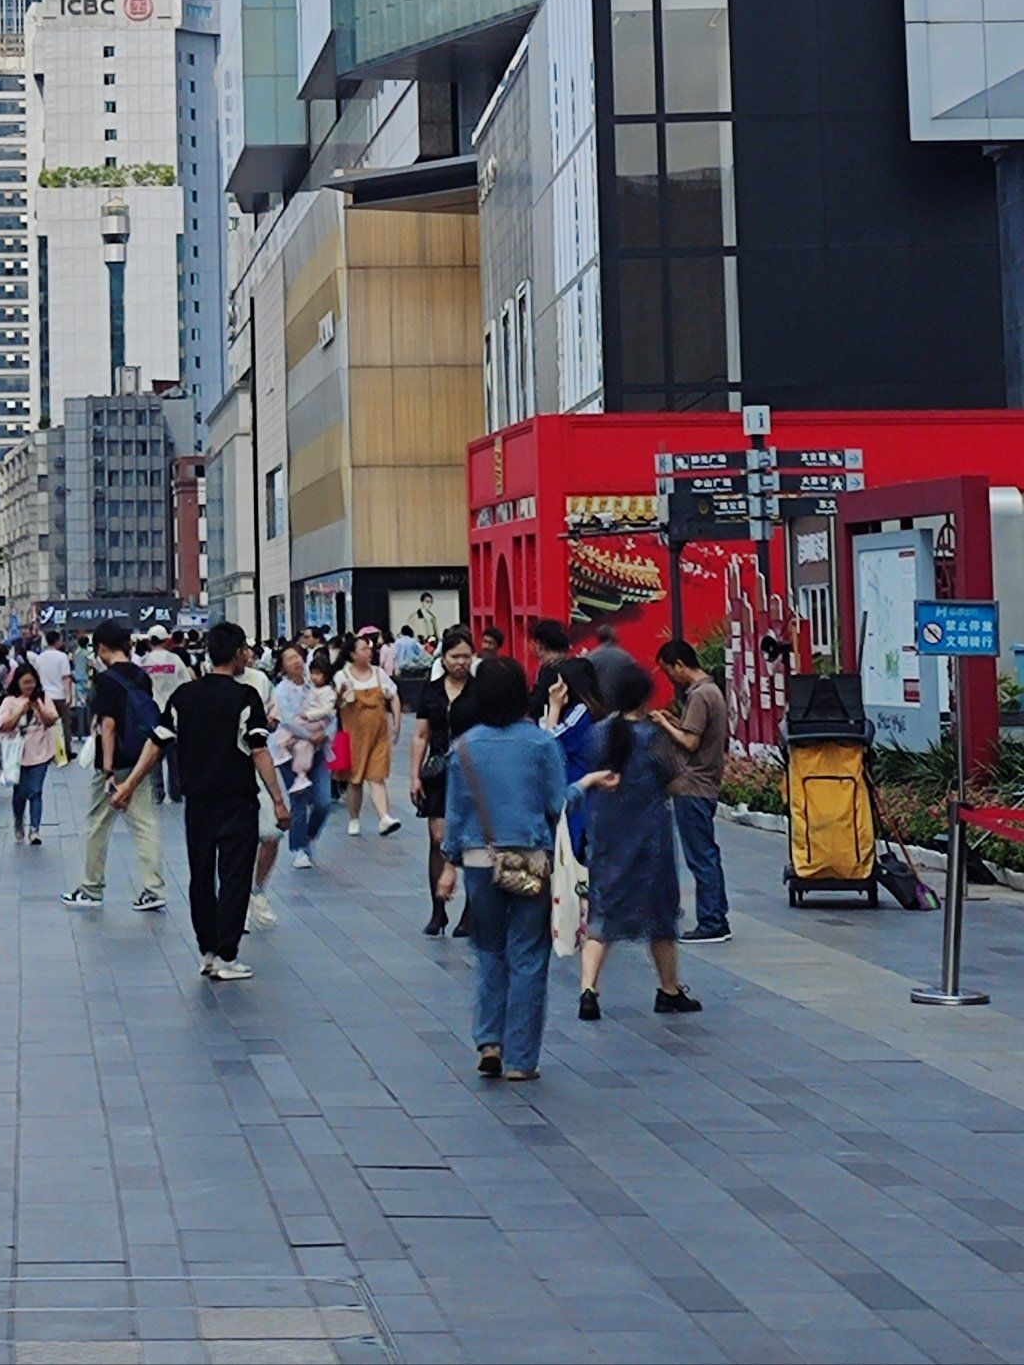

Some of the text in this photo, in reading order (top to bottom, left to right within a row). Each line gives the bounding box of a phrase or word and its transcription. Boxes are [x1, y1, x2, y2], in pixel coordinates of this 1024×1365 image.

[945, 620, 993, 632] 禁止停放
[945, 635, 993, 648] 文明骑行
